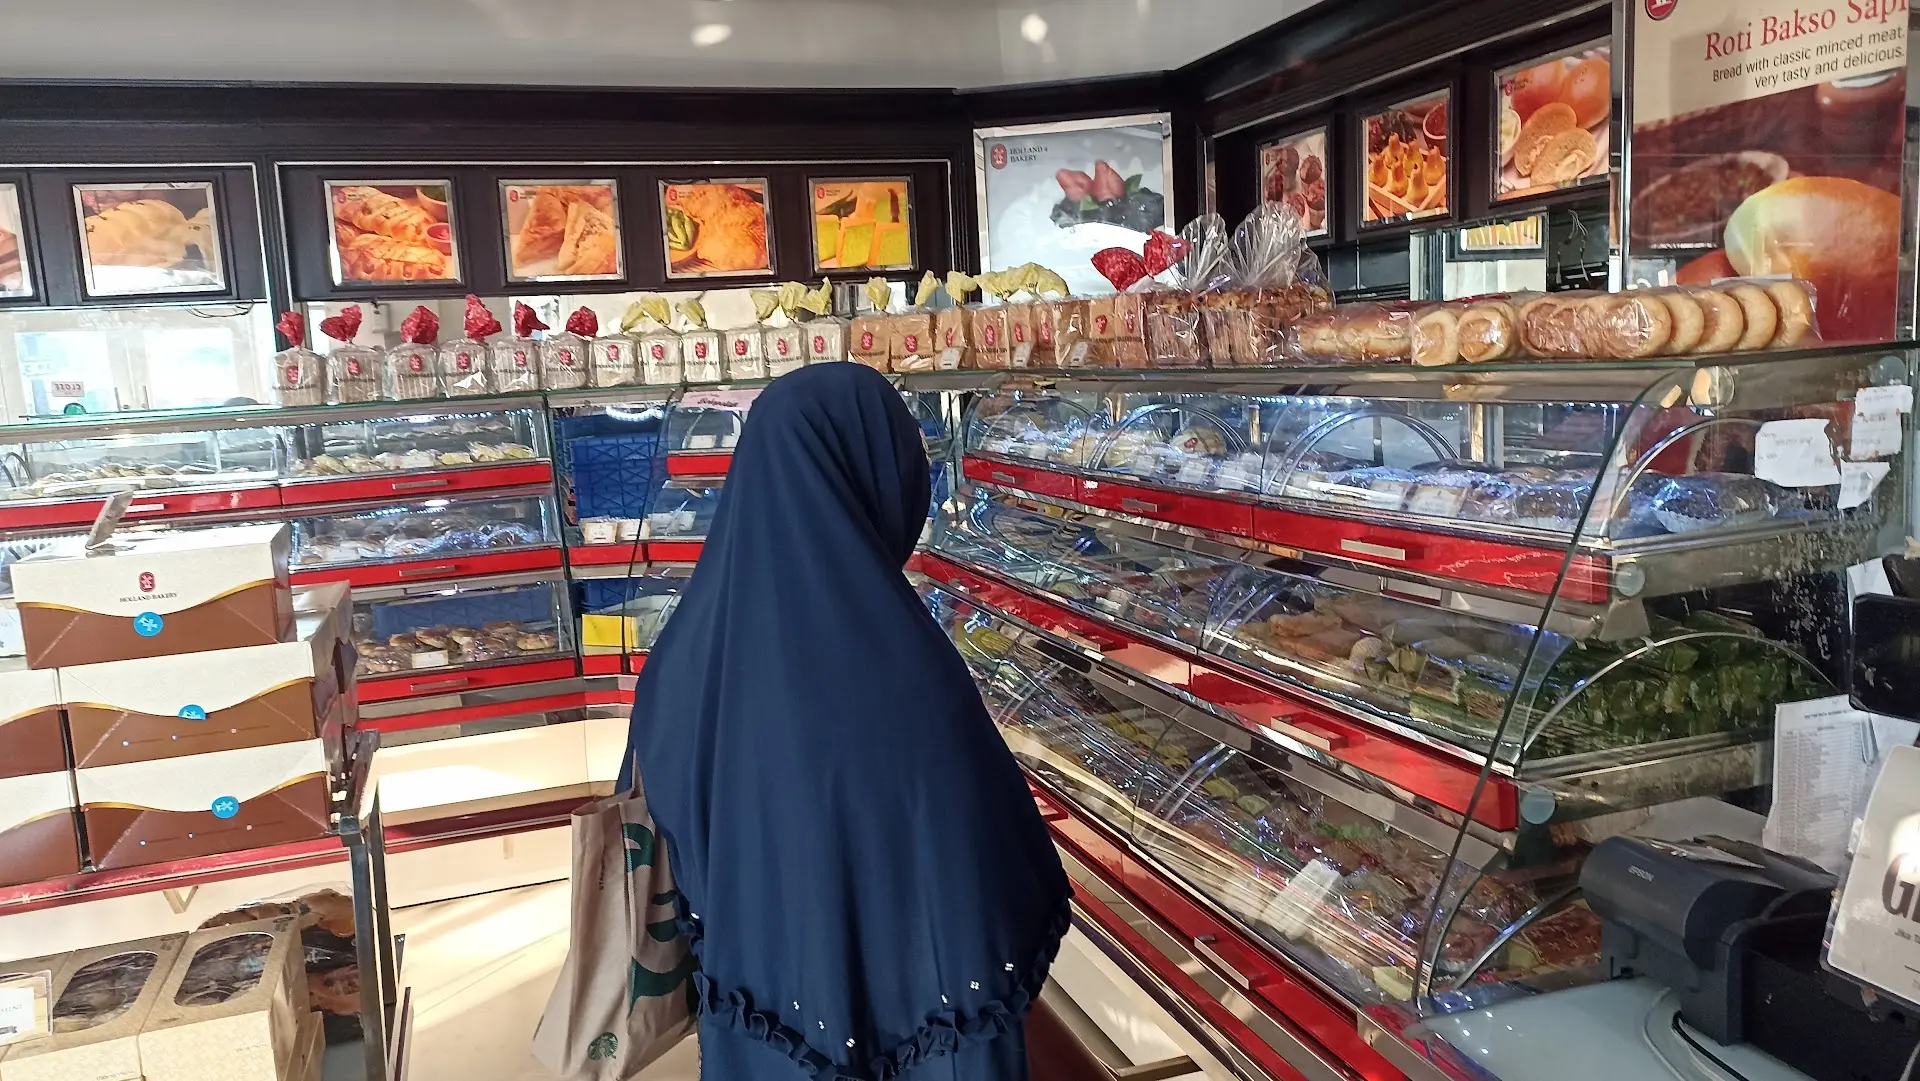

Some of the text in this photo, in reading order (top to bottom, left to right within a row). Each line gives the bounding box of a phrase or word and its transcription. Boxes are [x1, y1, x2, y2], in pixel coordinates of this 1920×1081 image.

[1705, 22, 1752, 61] Roti
[1761, 8, 1836, 46] Bakso
[1713, 26, 1905, 82] Bread with classic minced meat.
[1782, 65, 1811, 82] tasty
[1815, 57, 1838, 75] and
[1843, 46, 1905, 69] delicious.
[1010, 145, 1043, 155] HOLLAND
[1010, 154, 1037, 163] BAKERY
[120, 592, 178, 603] HOLLAND BAKERY
